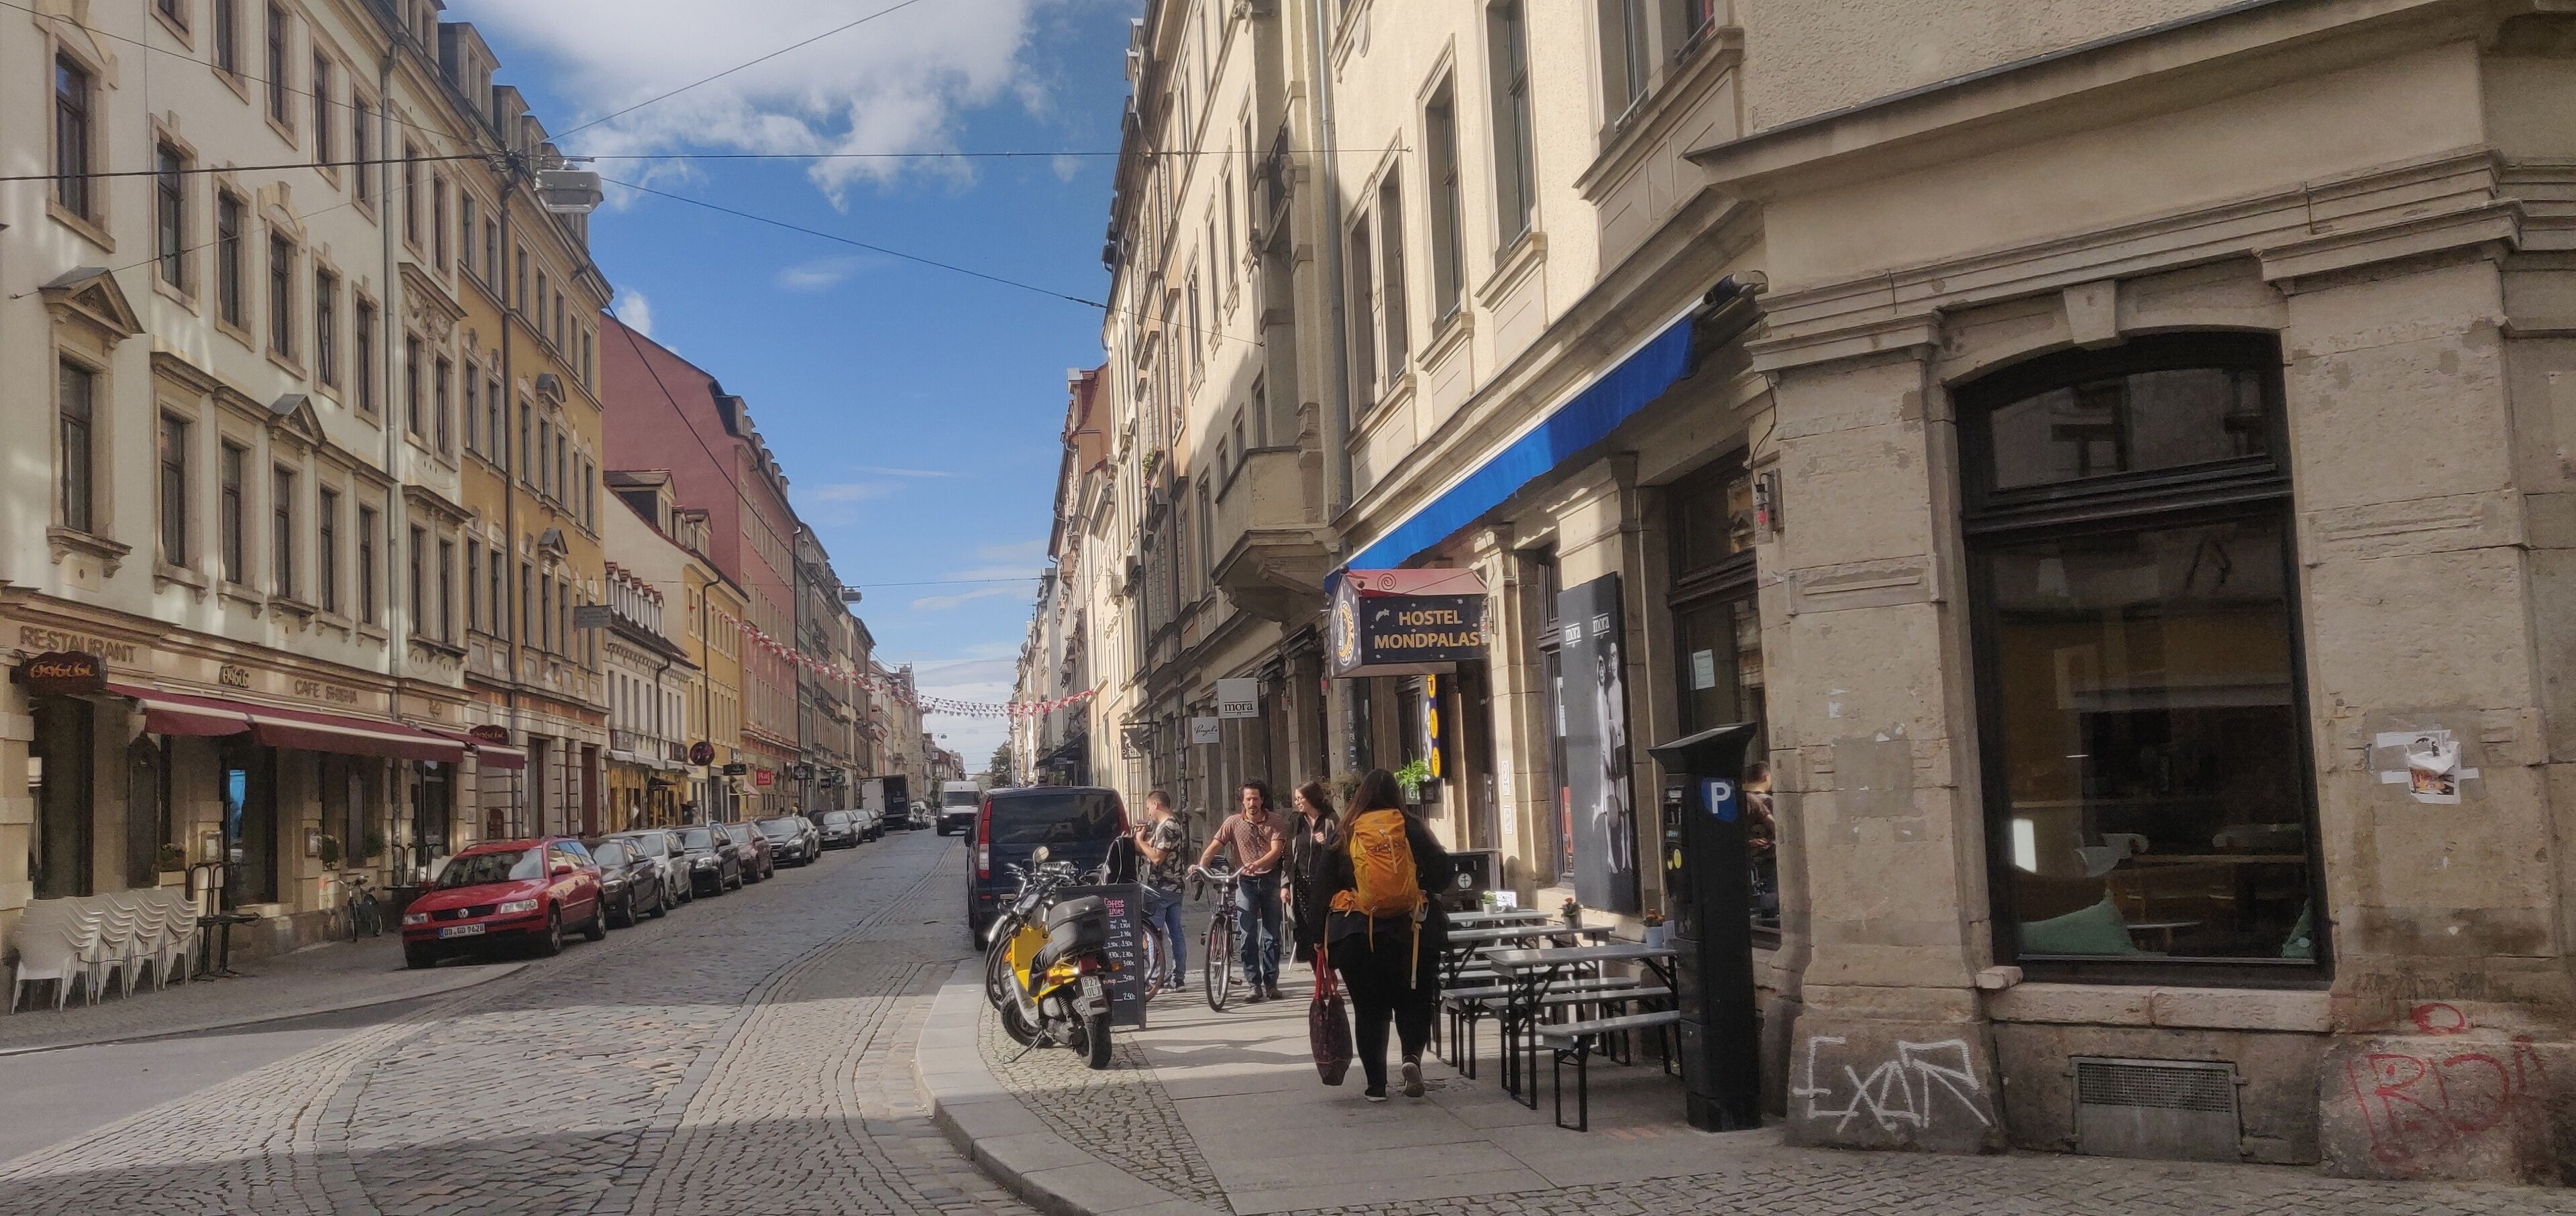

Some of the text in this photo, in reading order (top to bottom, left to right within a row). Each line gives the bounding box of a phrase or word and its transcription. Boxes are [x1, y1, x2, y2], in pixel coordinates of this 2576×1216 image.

[1399, 610, 1463, 626] HOSTEL
[1593, 616, 1610, 633] mora
[1374, 632, 1481, 649] MONDPALAS
[1565, 626, 1581, 642] mora
[19, 625, 136, 663] RESTAURANT
[1224, 702, 1253, 712] mora
[1711, 782, 1731, 814] P
